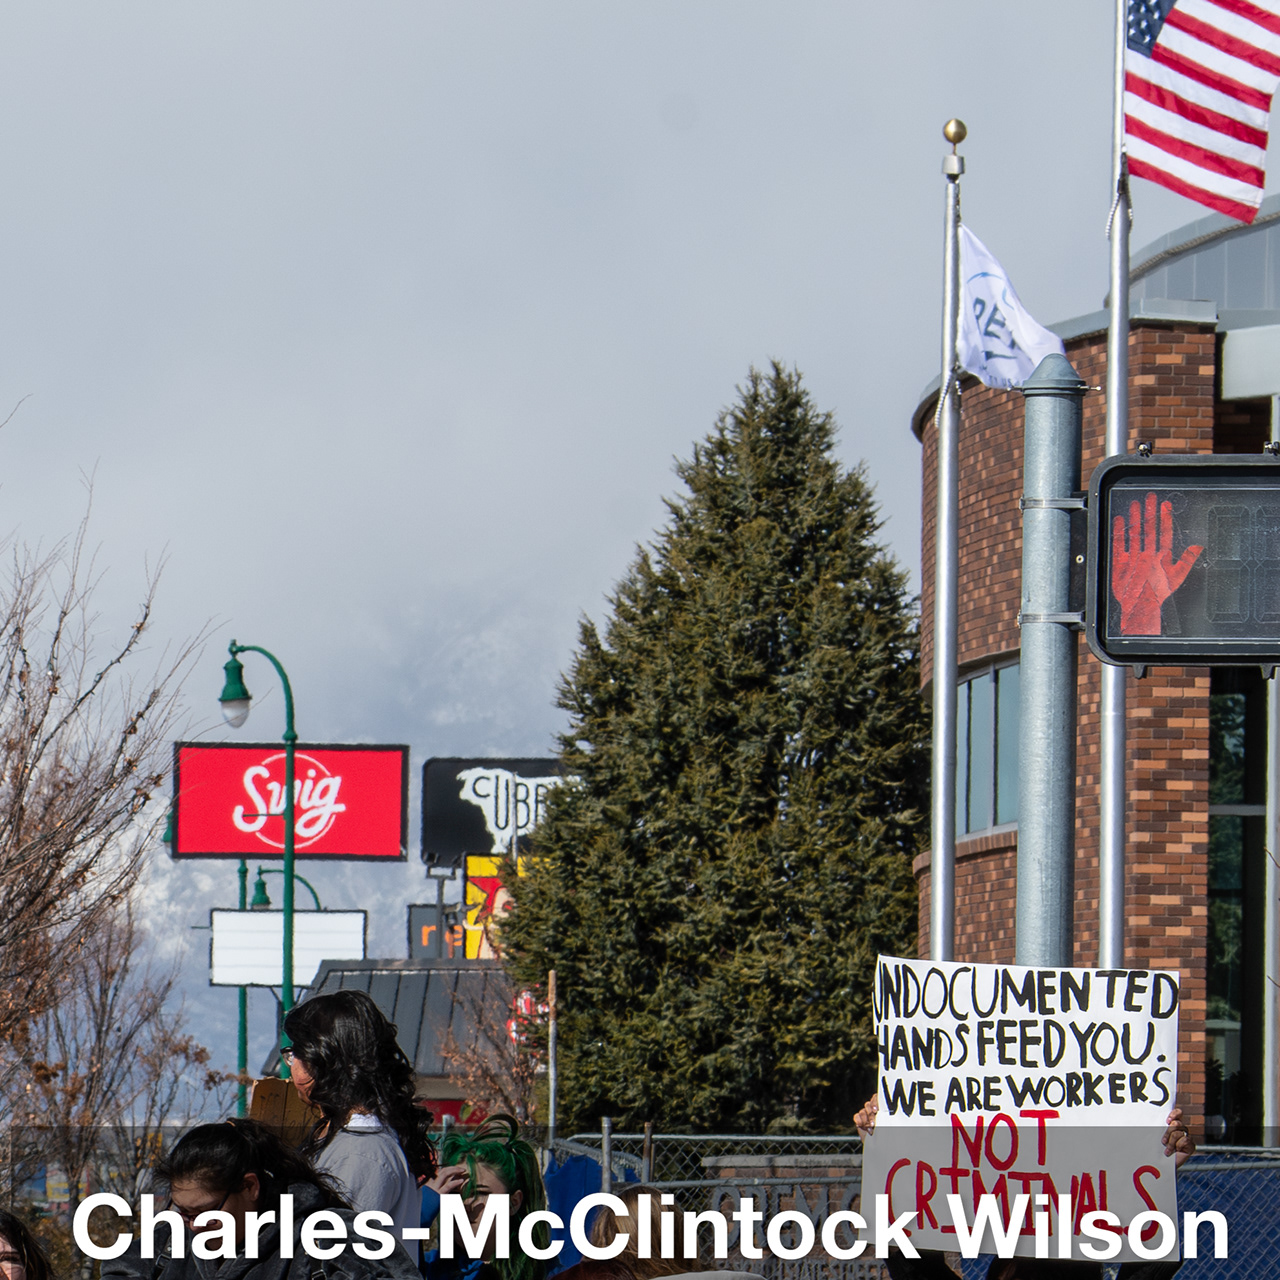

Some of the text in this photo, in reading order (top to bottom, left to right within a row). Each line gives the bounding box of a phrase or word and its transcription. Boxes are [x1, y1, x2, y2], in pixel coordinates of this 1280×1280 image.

[873, 962, 1178, 1022] UNDOCUMENTED
[878, 1019, 1167, 1071] HANDS FEED YOU.
[882, 1067, 1172, 1117] WE ARE WORKERS
[951, 1109, 1060, 1171] NOT
[884, 1158, 1161, 1242] CRIMINALS
